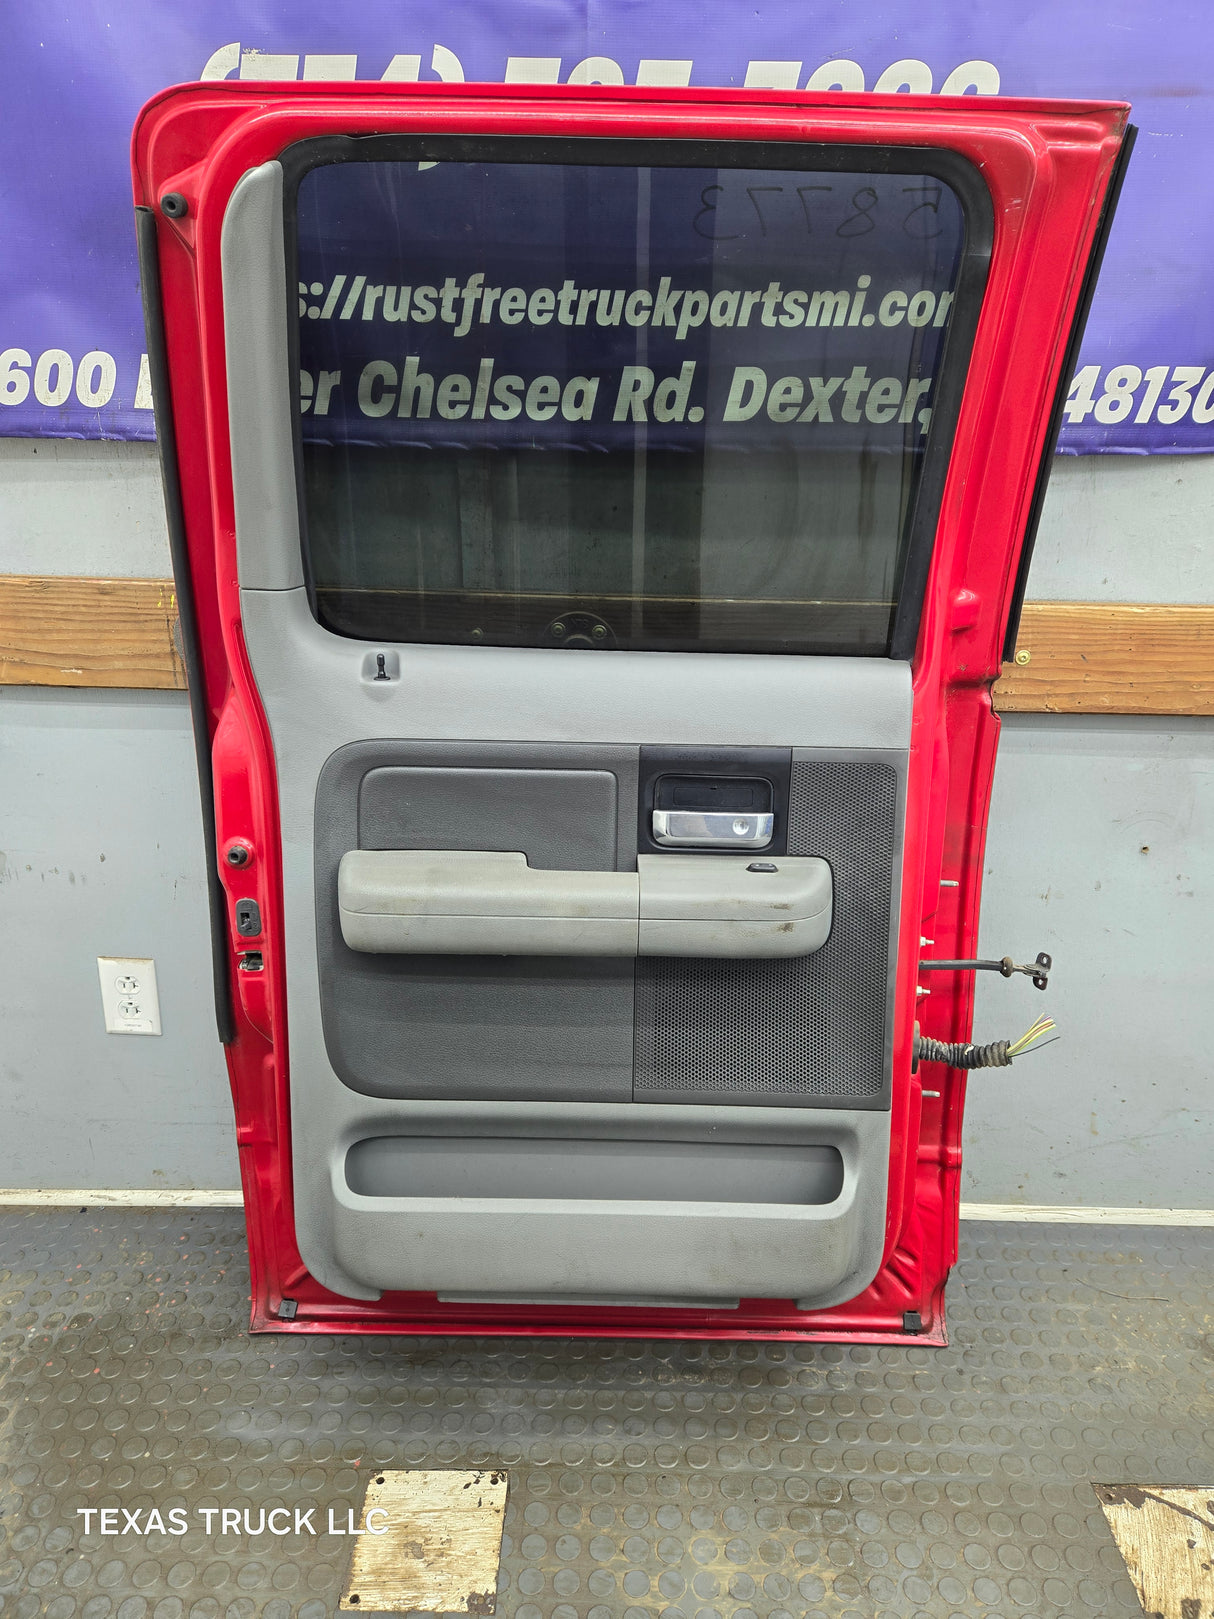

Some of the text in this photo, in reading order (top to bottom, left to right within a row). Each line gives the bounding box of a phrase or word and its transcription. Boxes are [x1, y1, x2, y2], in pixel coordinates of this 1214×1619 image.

[357, 356, 600, 422] Chelsea
[612, 360, 705, 423] Rd.
[722, 365, 933, 435] Dexter,
